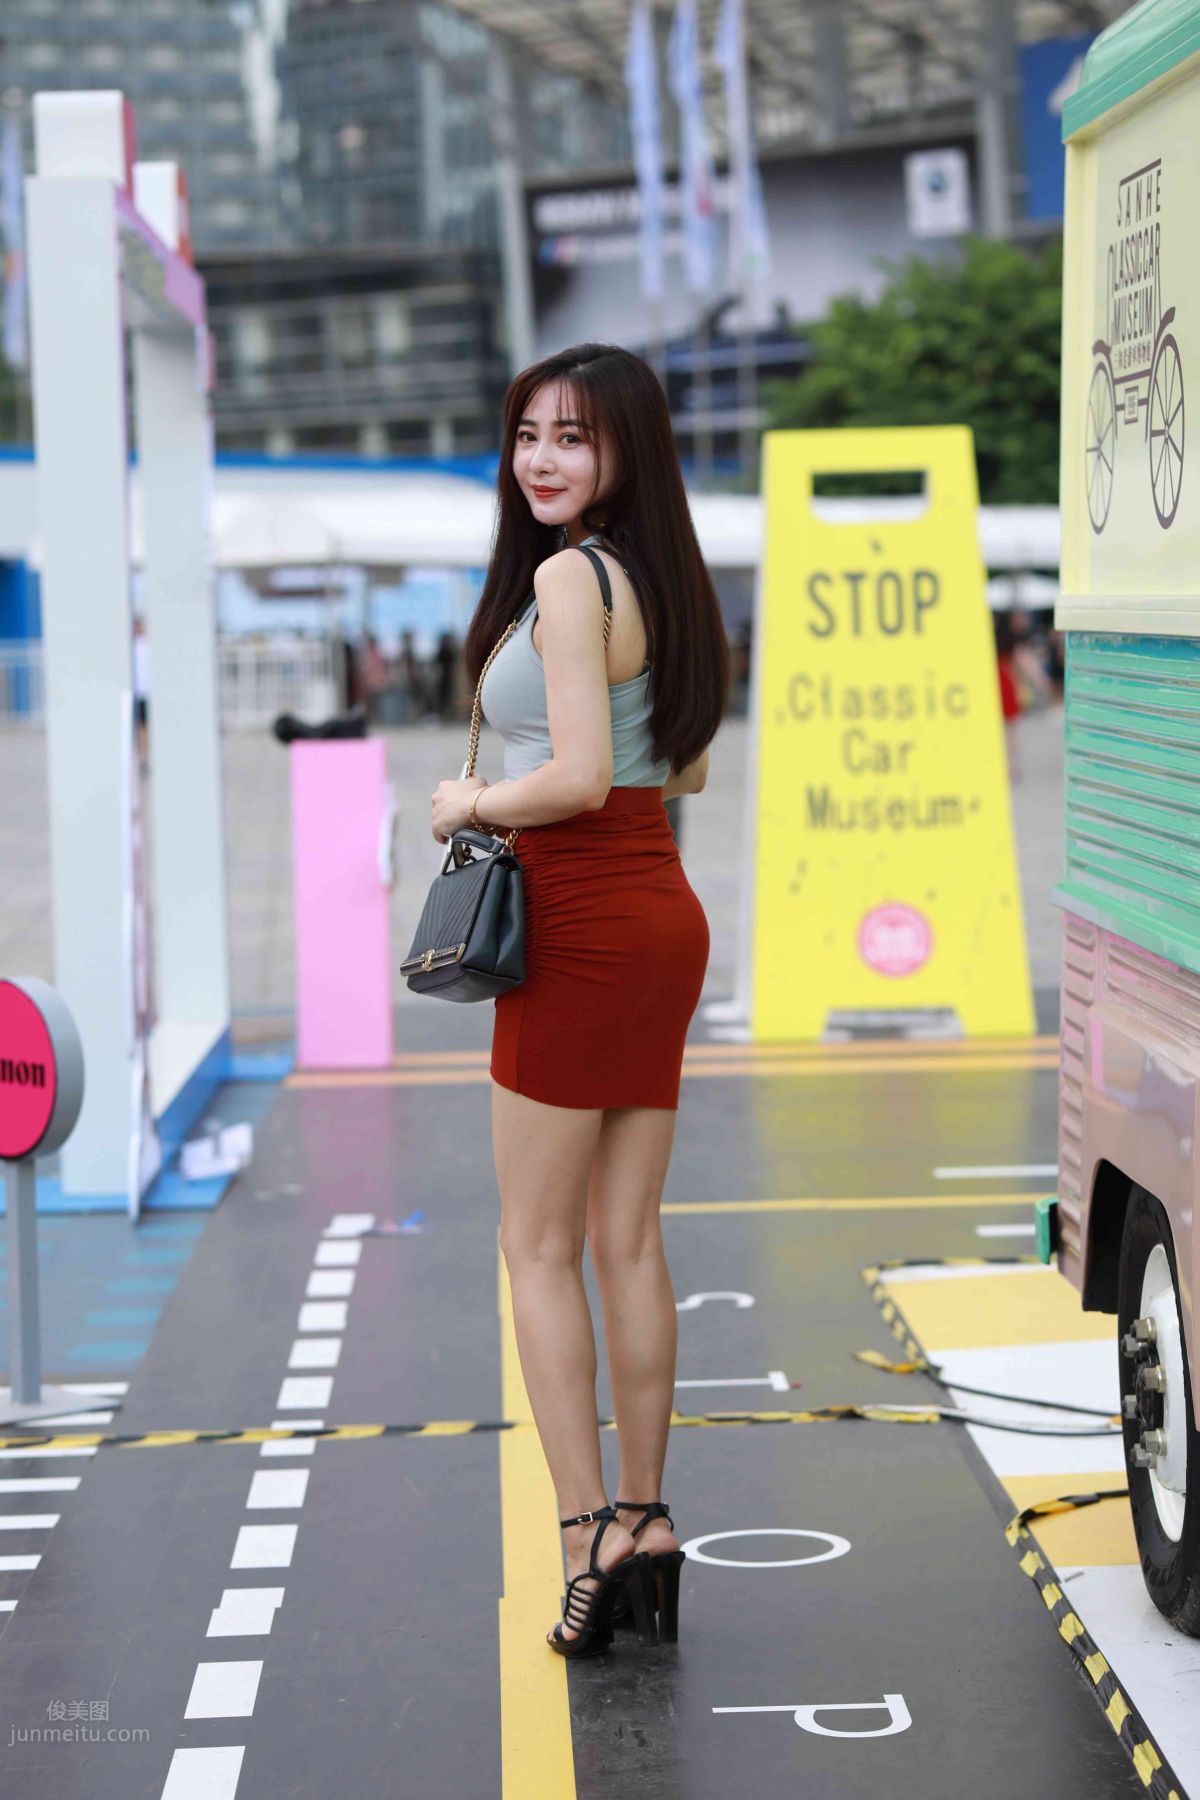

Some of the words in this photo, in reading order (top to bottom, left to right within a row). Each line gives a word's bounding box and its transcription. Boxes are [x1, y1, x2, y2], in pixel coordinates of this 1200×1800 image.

[1117, 166, 1161, 228] SANHE
[1110, 284, 1153, 345] MUSEUM
[806, 569, 941, 639] STOP
[786, 671, 970, 722] Classic
[841, 726, 915, 776] Car
[804, 783, 965, 831] Museum
